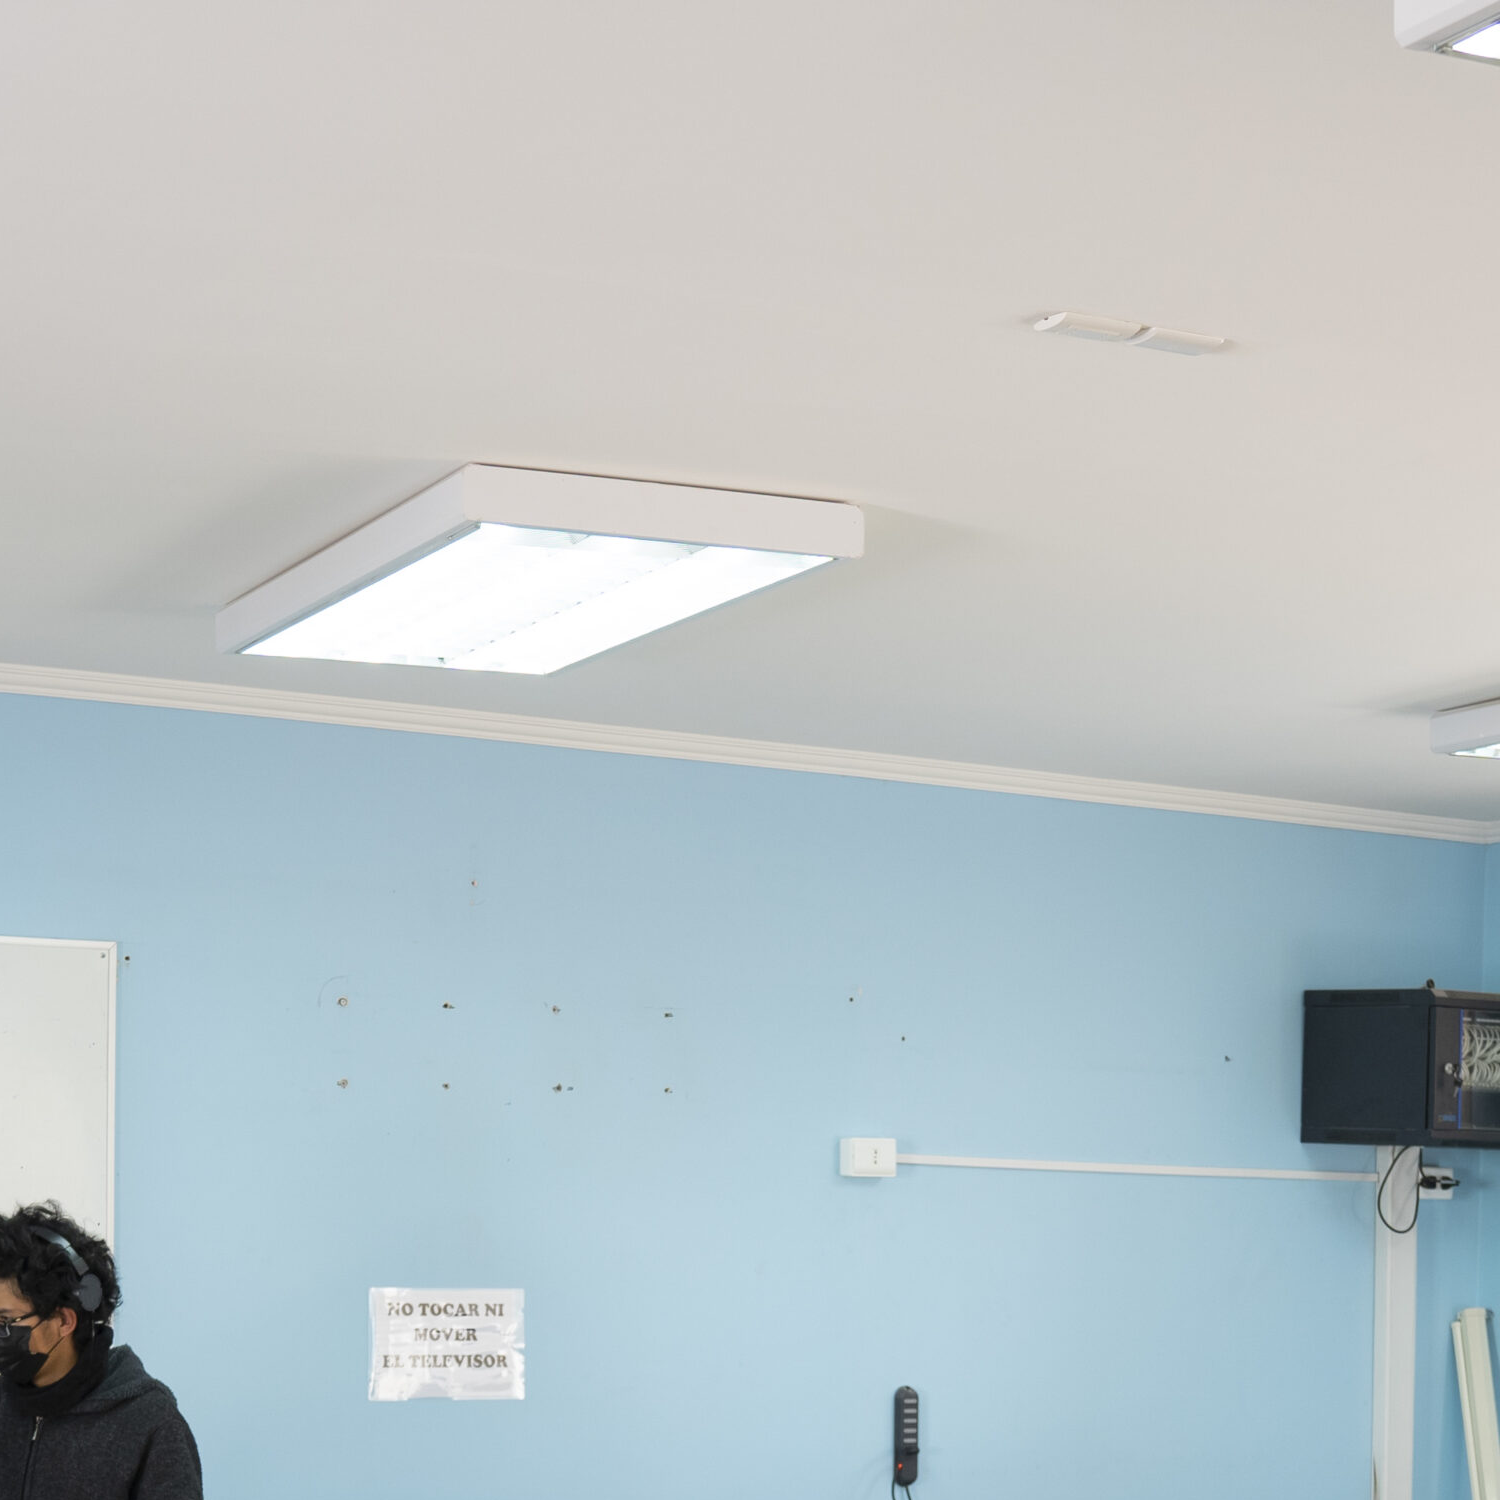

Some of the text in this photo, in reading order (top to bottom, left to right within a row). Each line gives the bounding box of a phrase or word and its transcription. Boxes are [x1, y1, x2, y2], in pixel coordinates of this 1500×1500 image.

[387, 1302, 505, 1318] NO TOCAR NI
[414, 1327, 478, 1342] MOVER
[382, 1354, 508, 1369] EL TELEVISOR
